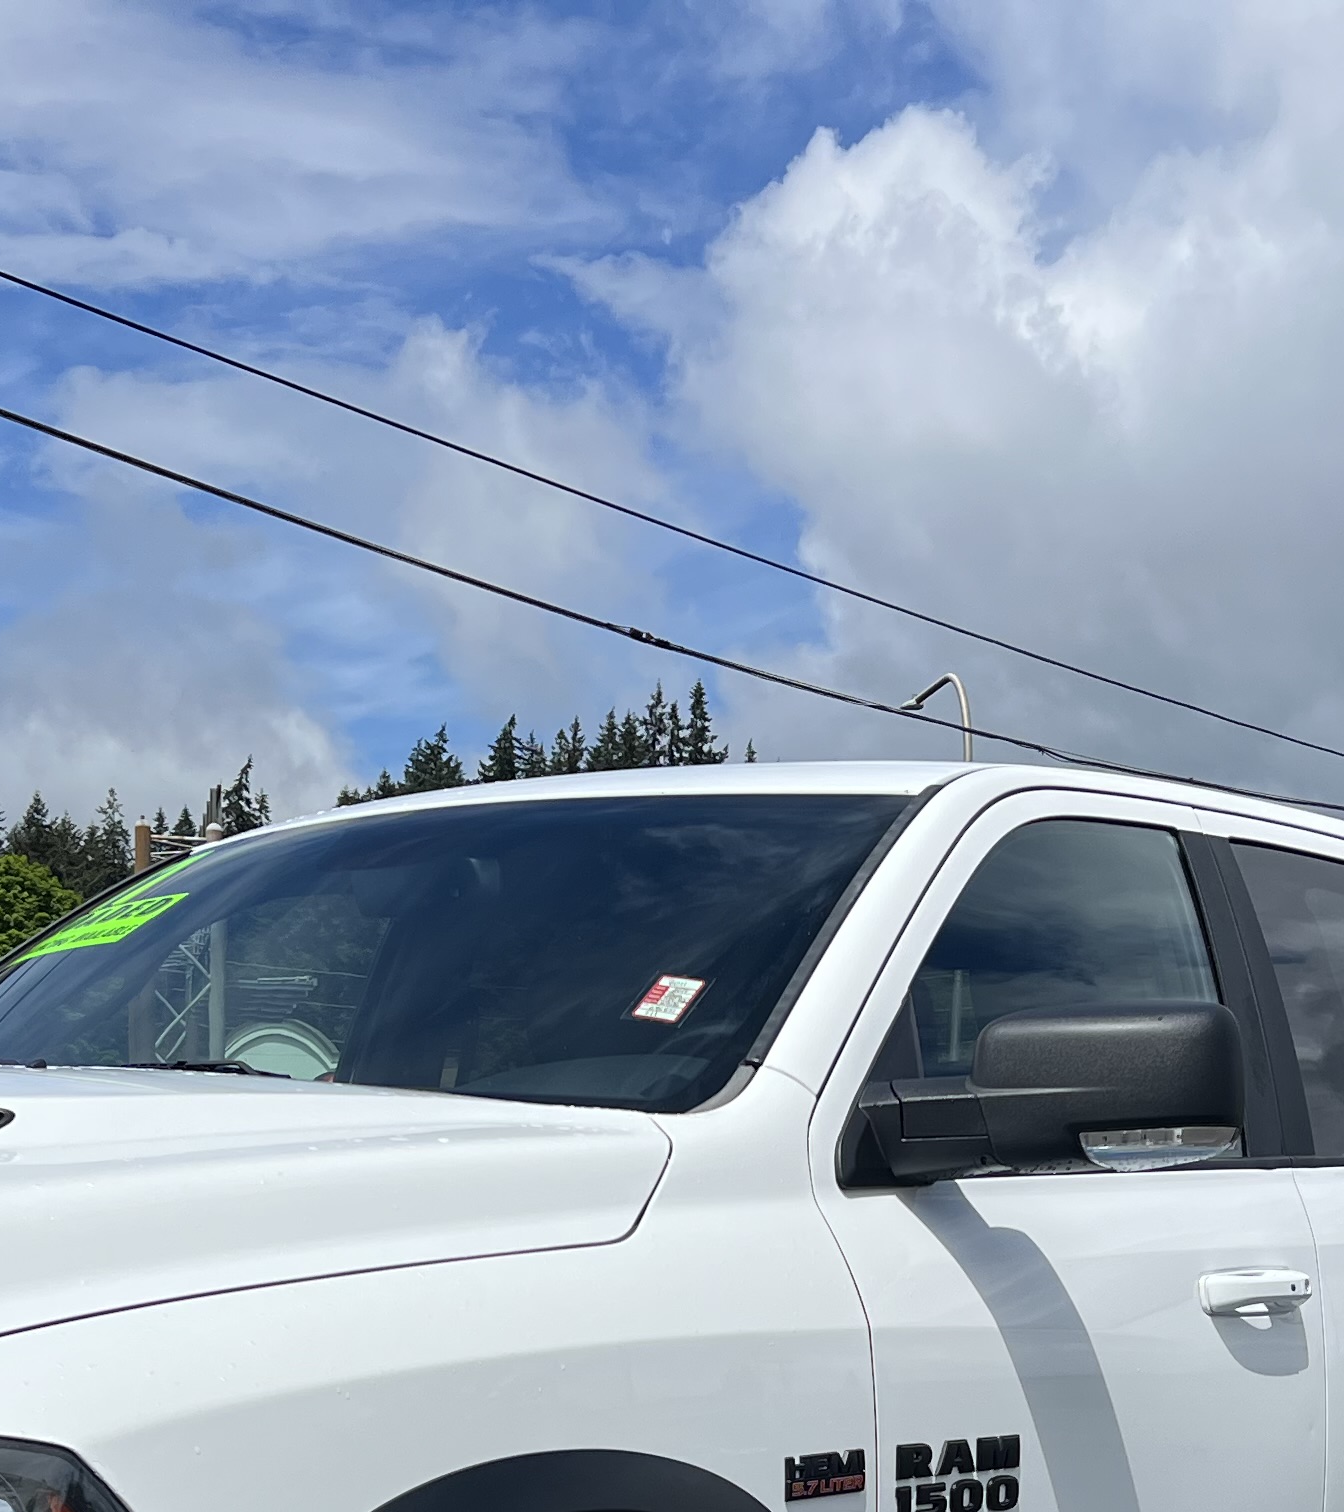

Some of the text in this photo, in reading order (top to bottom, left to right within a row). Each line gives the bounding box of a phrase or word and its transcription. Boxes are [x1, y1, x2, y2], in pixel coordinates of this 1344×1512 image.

[784, 1449, 865, 1479] HEMI
[895, 1434, 1021, 1481] RAM
[791, 1473, 864, 1498] 5.7 LITER
